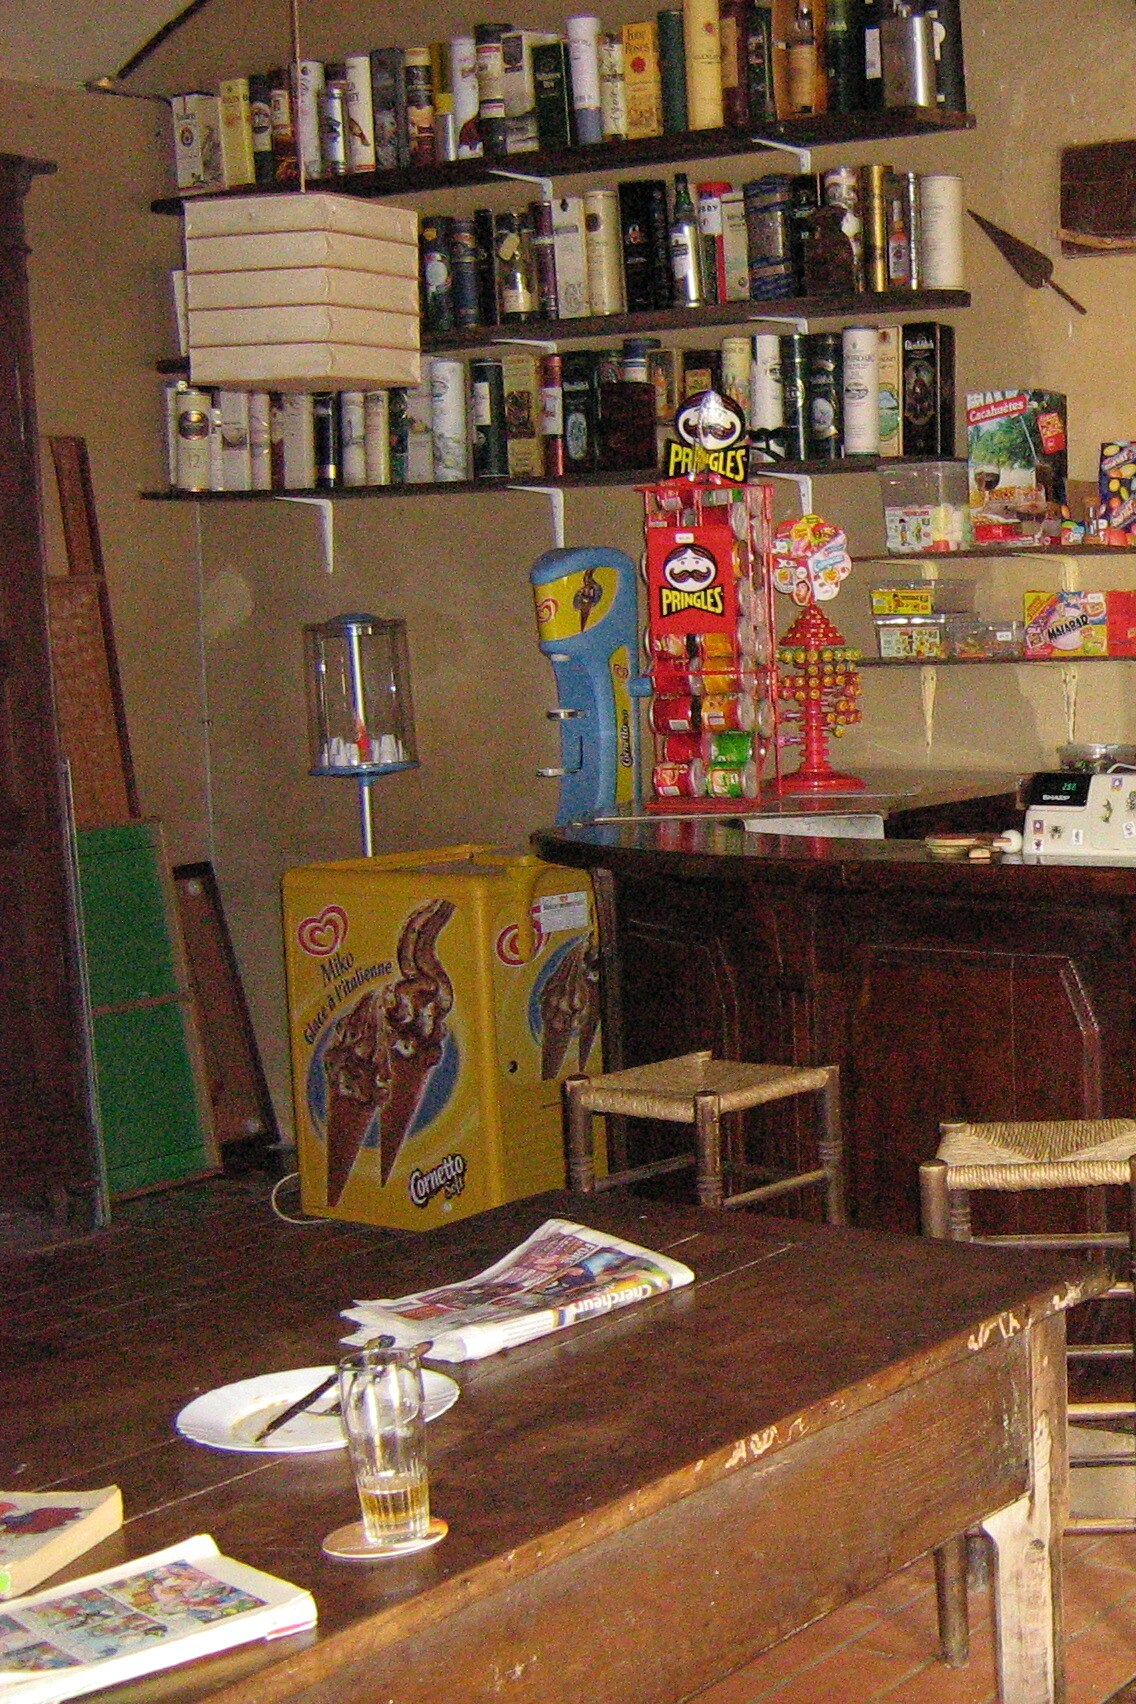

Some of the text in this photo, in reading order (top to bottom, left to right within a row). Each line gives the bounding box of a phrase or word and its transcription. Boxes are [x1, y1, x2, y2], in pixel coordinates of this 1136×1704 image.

[661, 586, 724, 616] PRINGLES
[320, 952, 355, 987] Miko
[304, 1007, 328, 1045] Glace
[334, 961, 393, 1003] l'italienne
[410, 1154, 465, 1206] Cornetto
